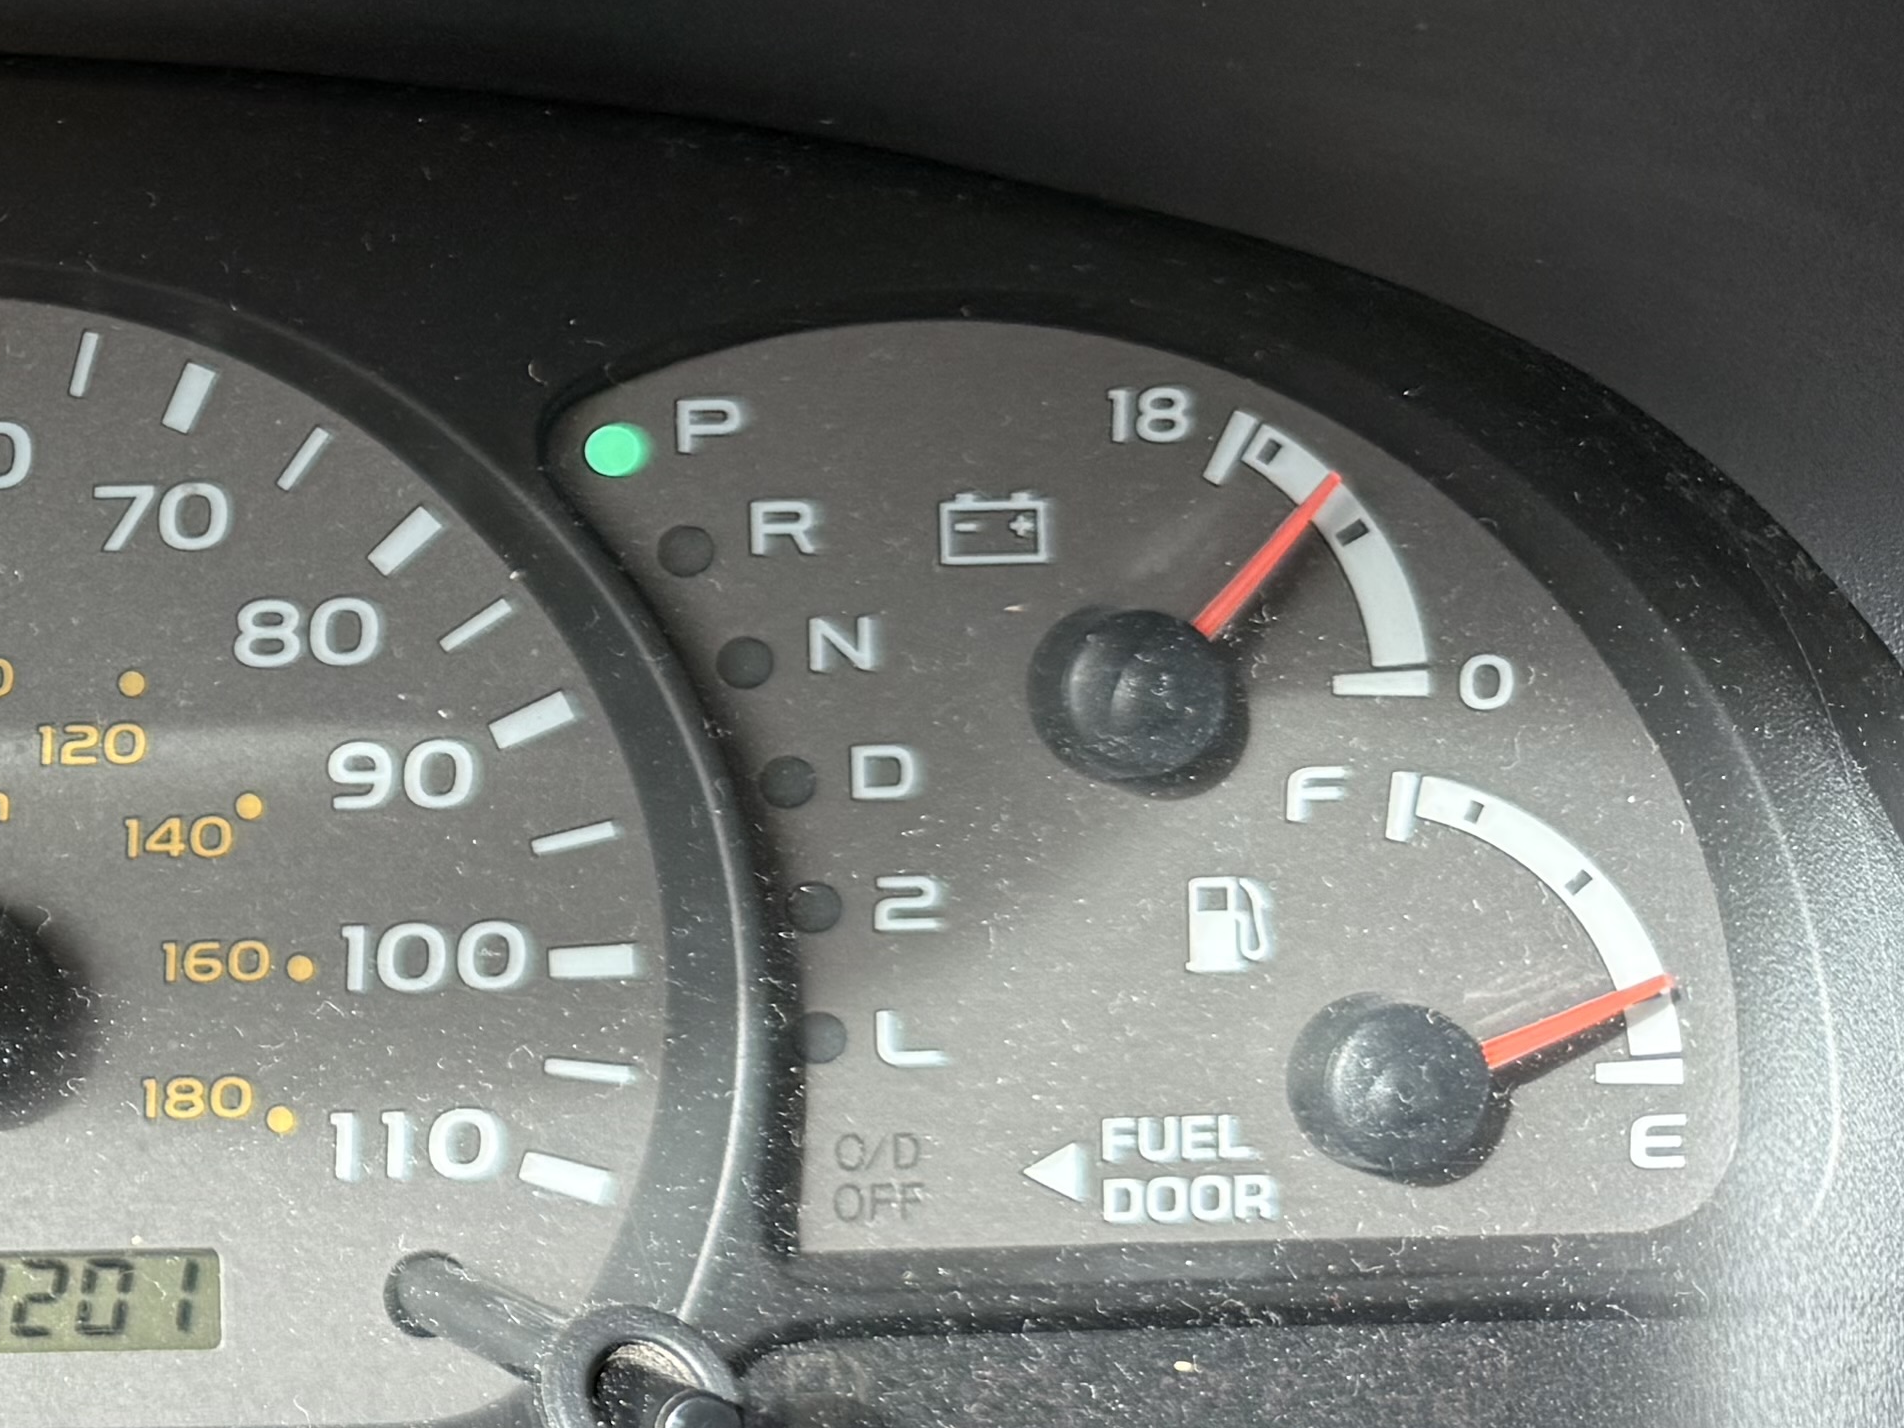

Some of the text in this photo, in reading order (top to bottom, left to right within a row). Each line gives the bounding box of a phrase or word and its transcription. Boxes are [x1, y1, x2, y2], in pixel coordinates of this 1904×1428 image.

[676, 398, 742, 453] P
[1108, 387, 1190, 443] 18
[94, 483, 230, 552] 70
[749, 500, 817, 556] R
[234, 597, 381, 668] 80
[808, 615, 877, 672] N
[37, 723, 146, 765] 120
[327, 740, 475, 810] 90
[850, 745, 918, 800] D
[1286, 766, 1350, 822] F
[125, 815, 233, 858] 140
[874, 876, 946, 932] 2
[162, 940, 272, 983] 160
[341, 920, 530, 992] 100
[874, 1010, 948, 1066] L
[142, 1076, 254, 1119] 180
[330, 1108, 504, 1181] 110
[833, 1133, 922, 1172] O/D
[1102, 1114, 1258, 1163] FUEL
[1629, 1114, 1687, 1169] E
[833, 1182, 925, 1224] OFF
[1102, 1175, 1279, 1224] DOOR
